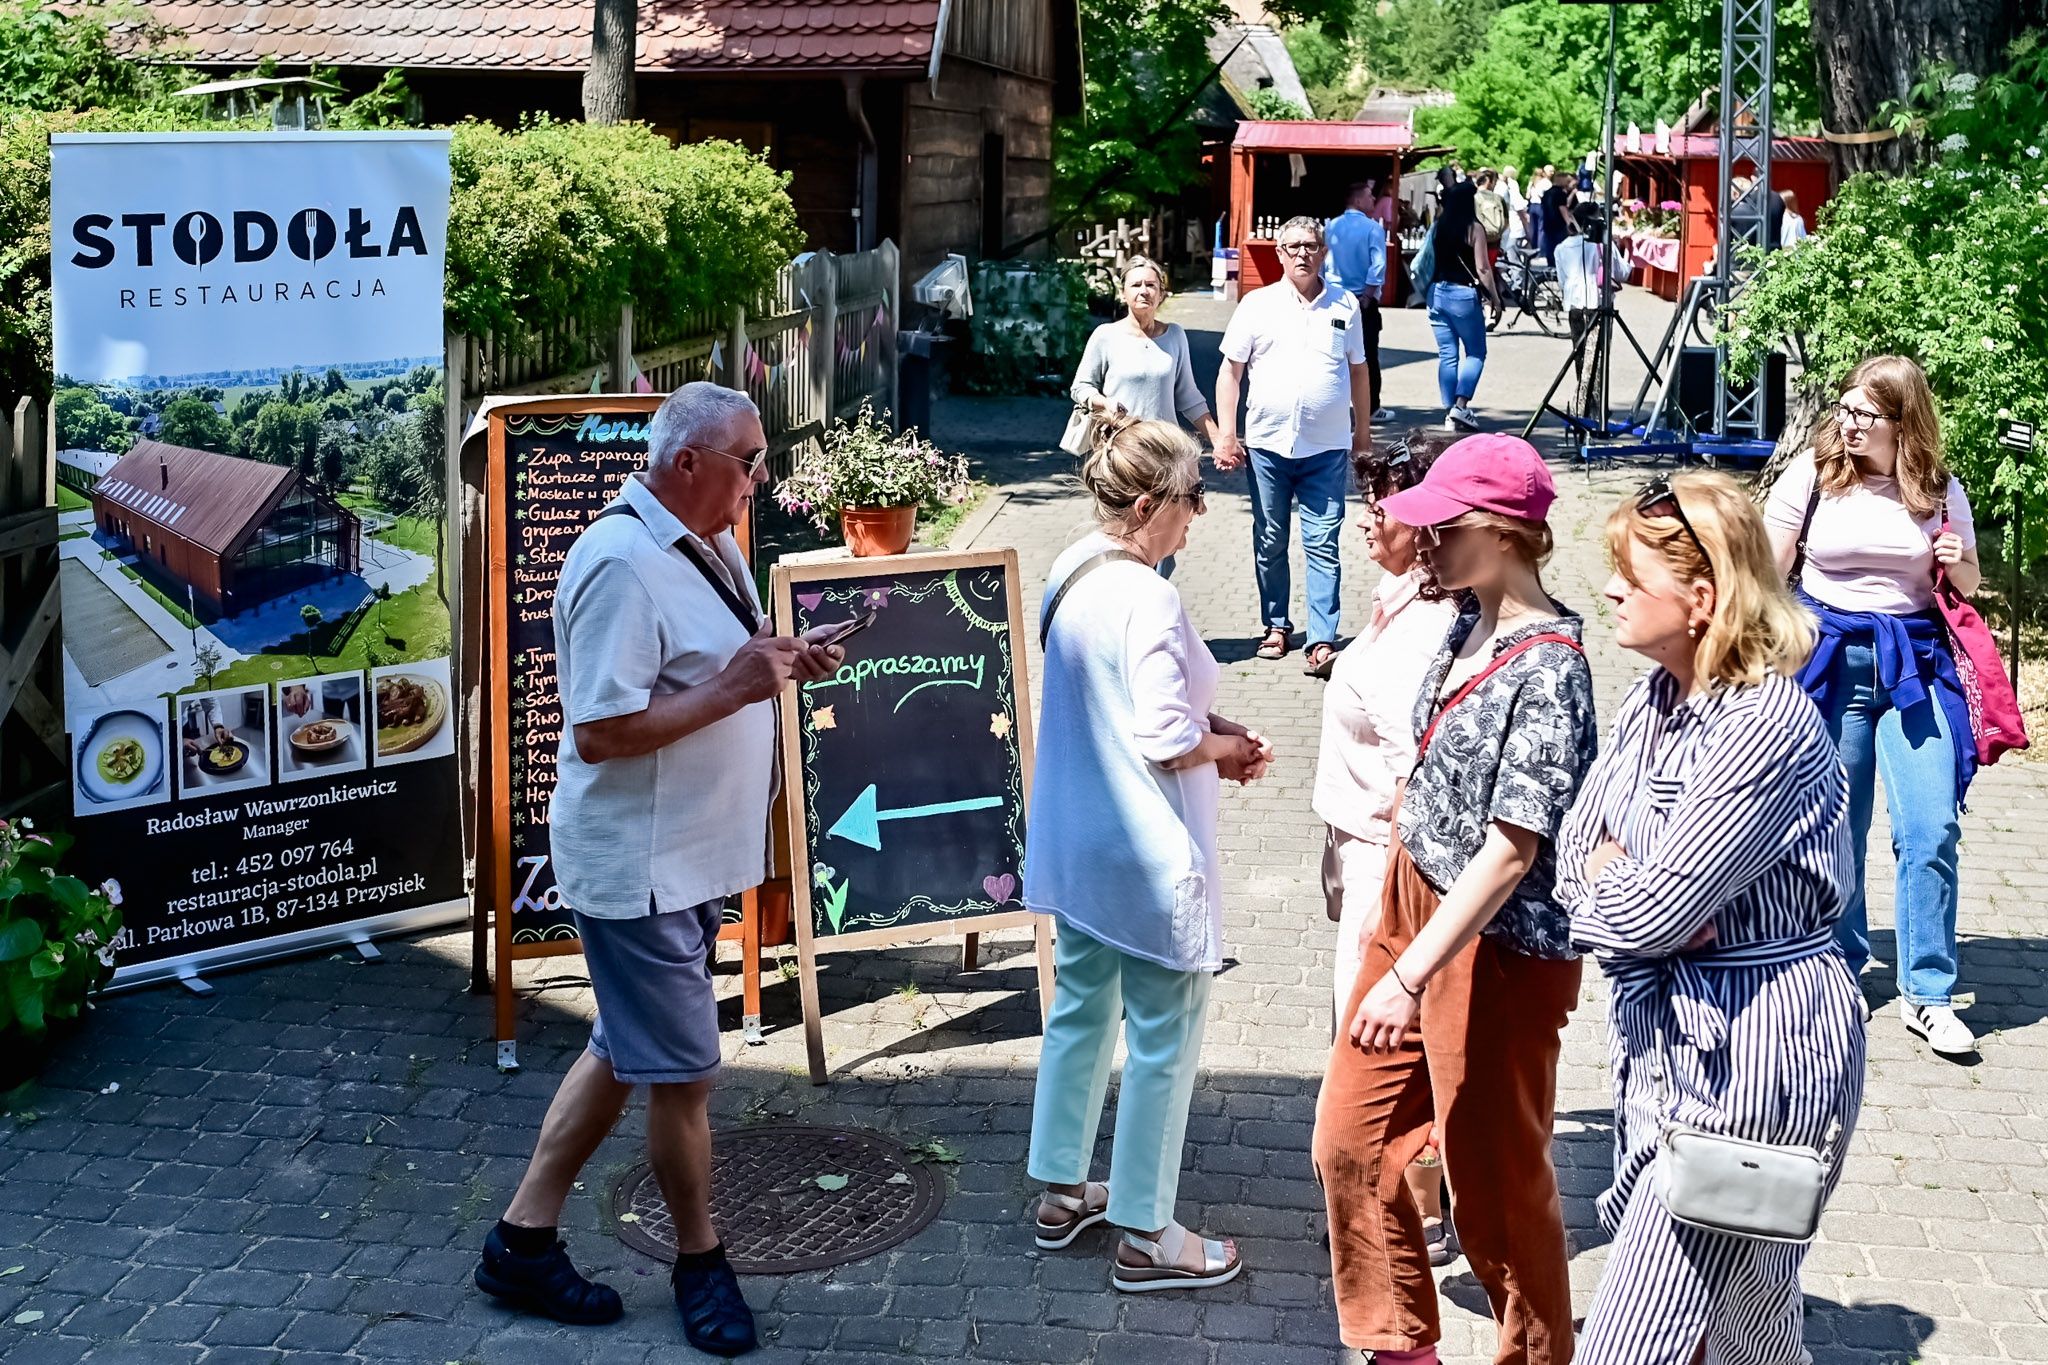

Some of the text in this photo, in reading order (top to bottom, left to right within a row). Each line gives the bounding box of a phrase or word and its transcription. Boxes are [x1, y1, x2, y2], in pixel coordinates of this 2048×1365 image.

[70, 206, 429, 272] STODOŁA
[120, 278, 387, 308] RESTAURACJA
[528, 448, 573, 470] Zupa
[528, 468, 596, 484] Kartacze
[527, 487, 584, 500] Moskale
[588, 491, 597, 499] w
[528, 503, 581, 521] Gulasz
[530, 547, 566, 564] Stek
[803, 654, 984, 713] apraszamy
[526, 710, 560, 728] Piwo
[146, 779, 397, 835] Radosław Wawrzonkiewicz
[243, 816, 310, 841] Manager
[191, 837, 355, 884] tel.: 452 097 764
[166, 857, 378, 915] restauracja-stodola.pl
[147, 914, 235, 945] Parkowa
[241, 906, 270, 929] 1B,
[276, 890, 339, 919] 87-134
[346, 873, 426, 907] Przysiek
